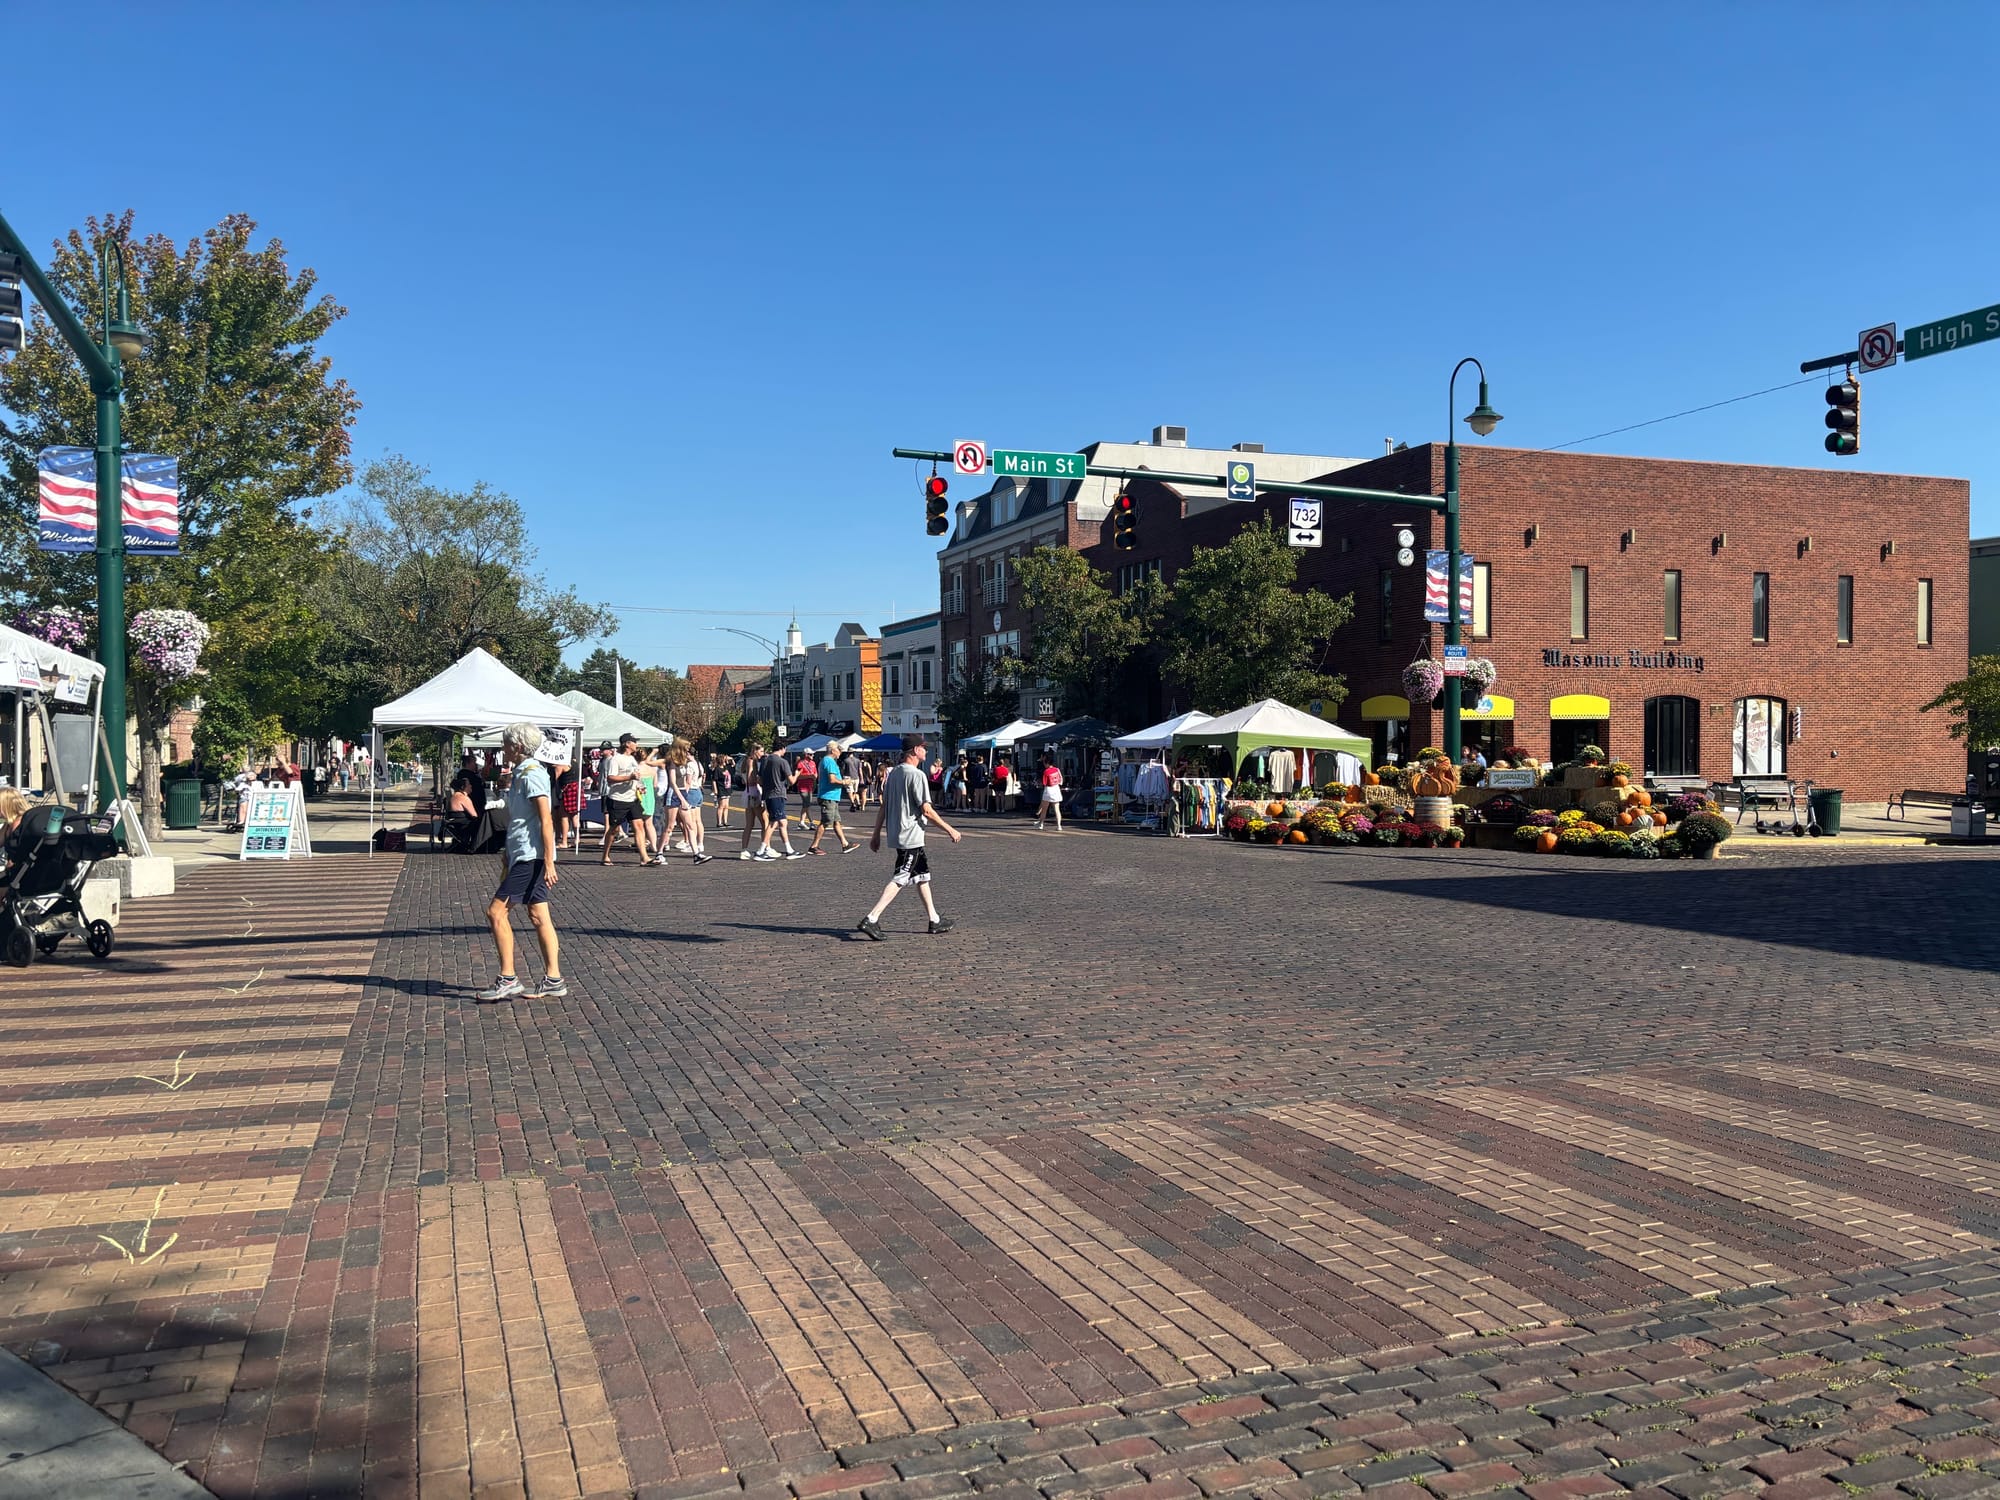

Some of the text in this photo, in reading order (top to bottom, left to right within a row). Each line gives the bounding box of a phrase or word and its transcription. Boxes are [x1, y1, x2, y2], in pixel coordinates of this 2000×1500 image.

[1920, 311, 2000, 350] High S
[1004, 455, 1075, 474] Main St
[1293, 507, 1317, 522] 732
[41, 530, 96, 543] Welcome
[123, 535, 177, 546] Welcome
[1541, 649, 1705, 673] Masonic Building
